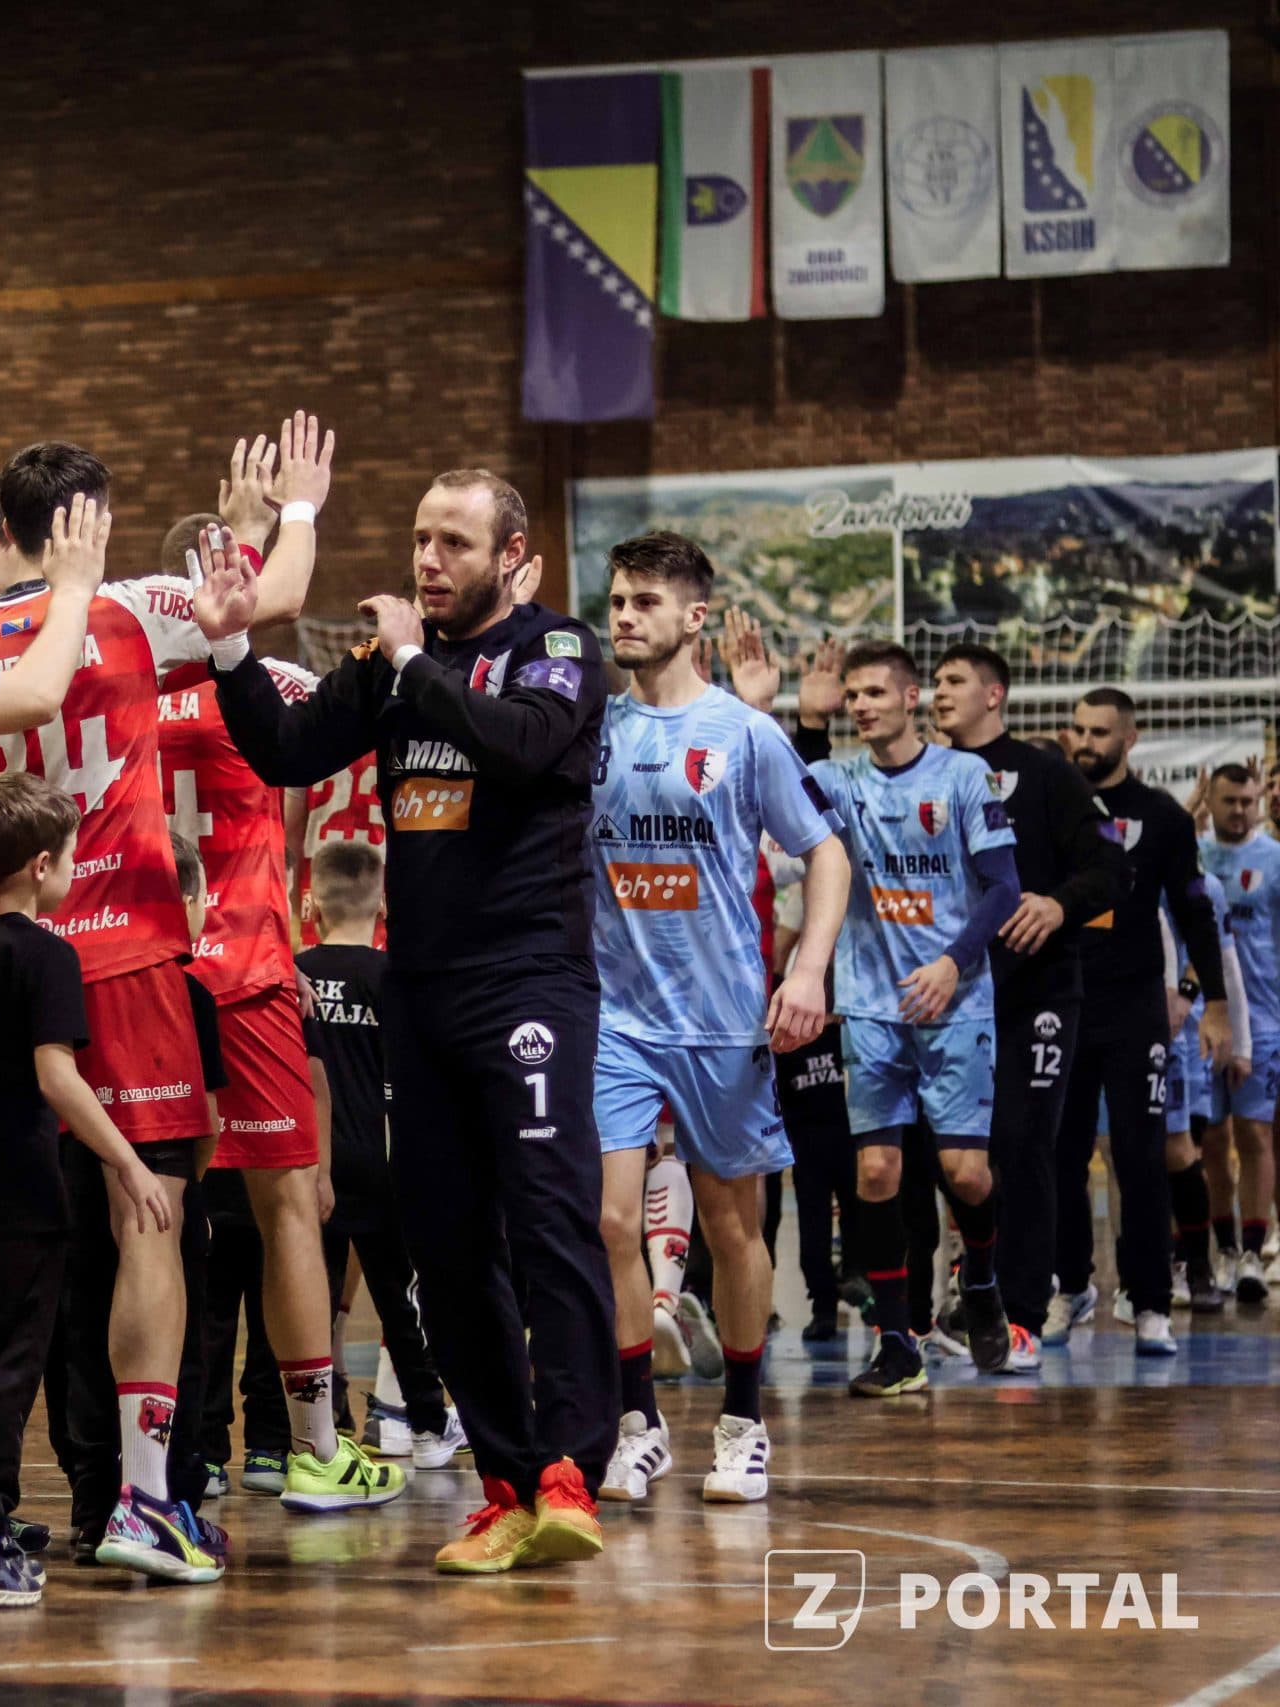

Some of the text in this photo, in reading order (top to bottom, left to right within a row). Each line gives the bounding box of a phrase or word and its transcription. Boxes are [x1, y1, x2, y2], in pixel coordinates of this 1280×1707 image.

[146, 590, 194, 622] TURS
[630, 814, 717, 845] MIBRAL
[71, 854, 123, 879] ETALI
[884, 853, 951, 874] MIBRAL
[318, 1002, 379, 1027] VAJA
[1031, 1043, 1063, 1076] 12
[120, 1081, 192, 1103] avangarde
[524, 1072, 547, 1117] 1
[1147, 1074, 1168, 1103] 16
[230, 1116, 296, 1133] avangarde
